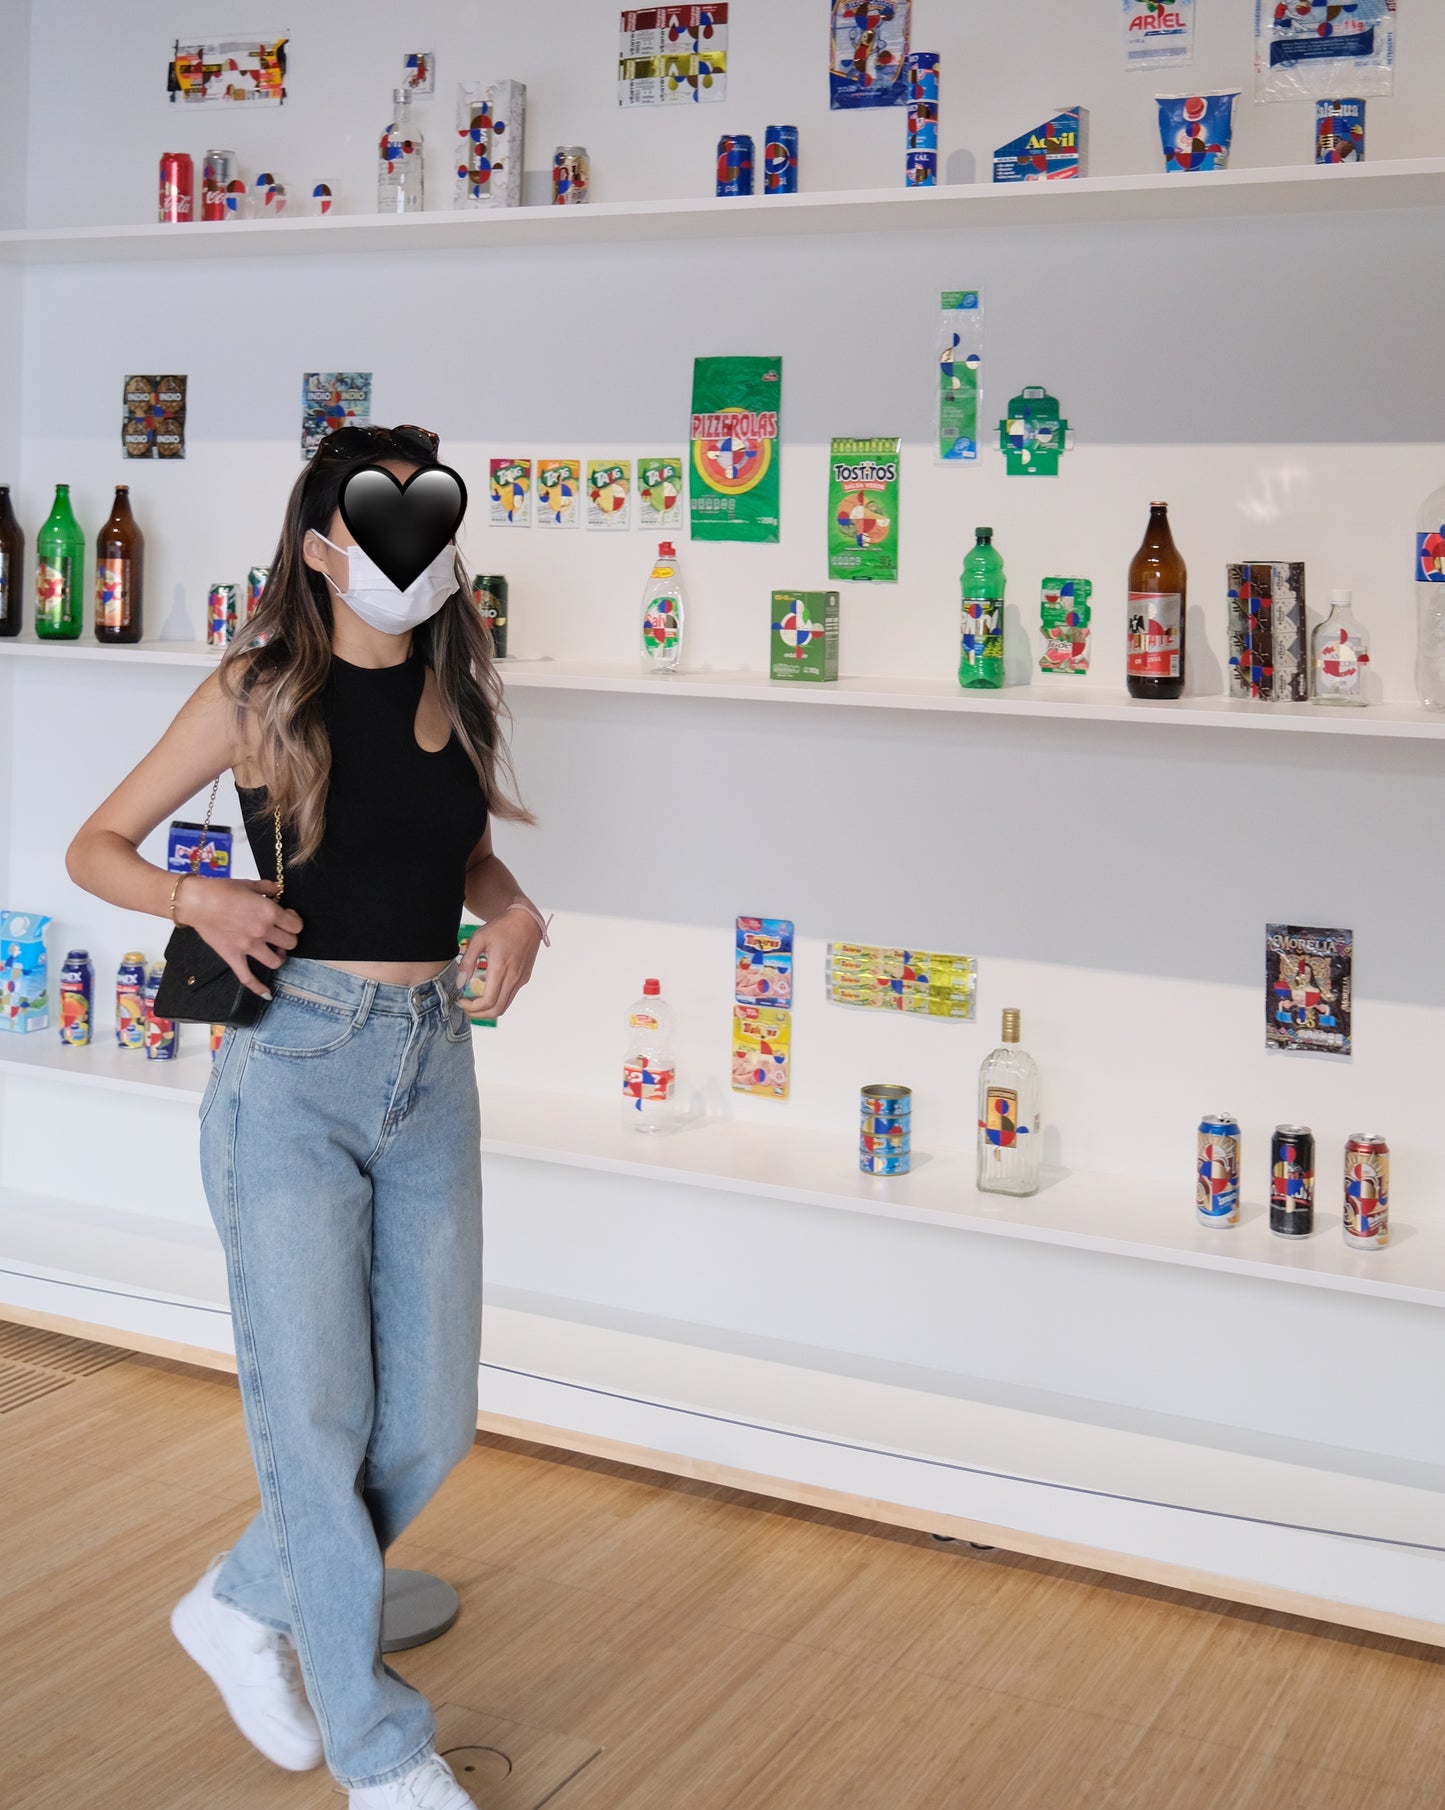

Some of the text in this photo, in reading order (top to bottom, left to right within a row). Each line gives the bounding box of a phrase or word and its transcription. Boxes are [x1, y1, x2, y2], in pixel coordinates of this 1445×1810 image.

[1129, 12, 1186, 31] ARIEL
[127, 392, 182, 401] INDIO INDIO
[308, 392, 366, 401] INDIO INDIO
[691, 411, 777, 440] PIZZEROLAS
[125, 434, 180, 443] INDIO INDIO
[1272, 935, 1337, 953] MORELIA
